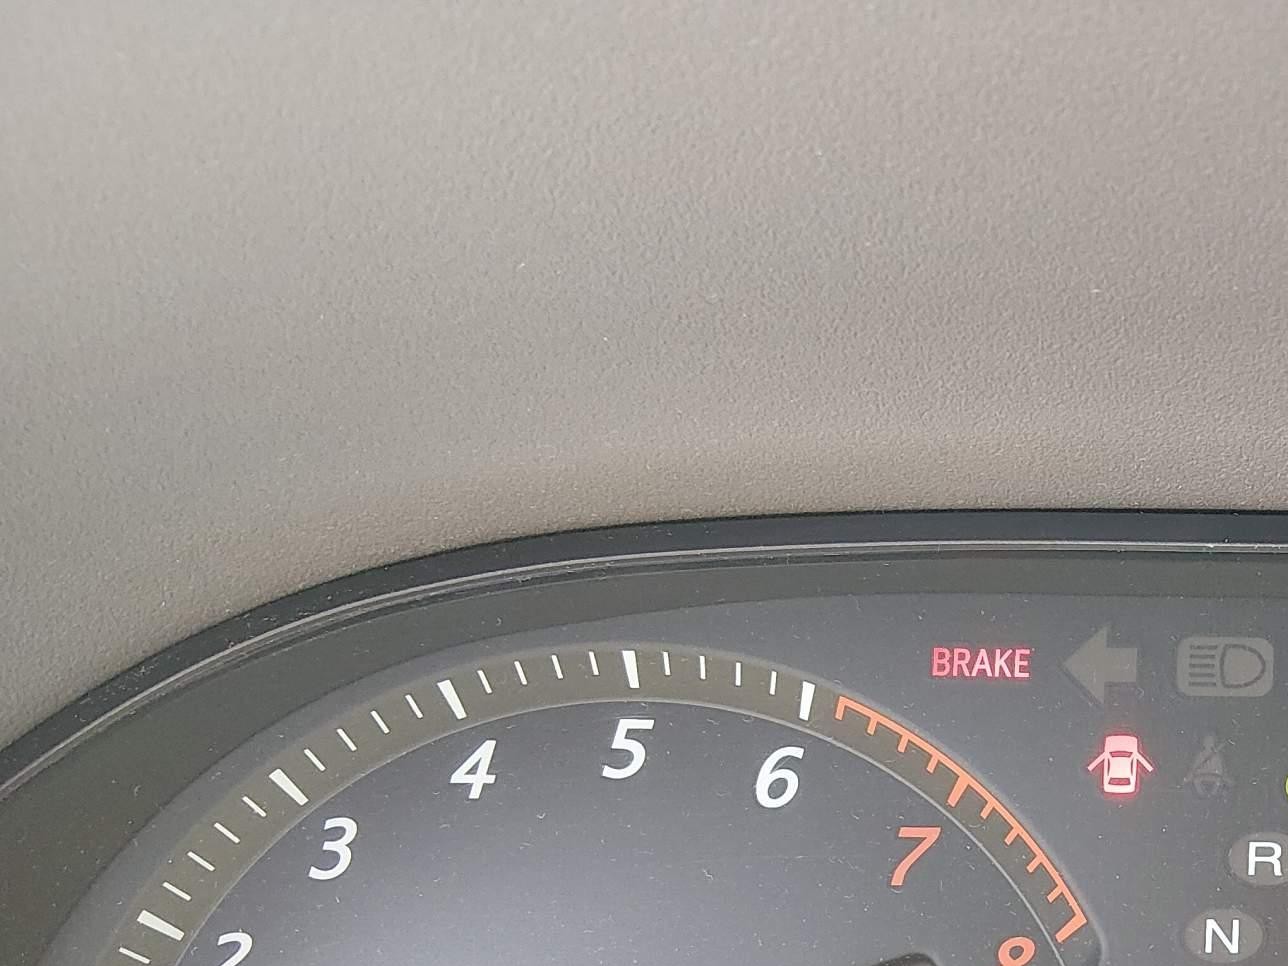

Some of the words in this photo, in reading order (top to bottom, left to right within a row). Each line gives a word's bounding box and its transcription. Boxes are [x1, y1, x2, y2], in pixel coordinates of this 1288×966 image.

[931, 647, 1032, 679] BRAKE
[449, 740, 497, 799] 4
[601, 718, 654, 779] 5
[754, 746, 804, 808] 6
[308, 817, 358, 880] 3
[889, 826, 940, 887] 7
[1248, 842, 1283, 876] R
[1204, 919, 1240, 954] N
